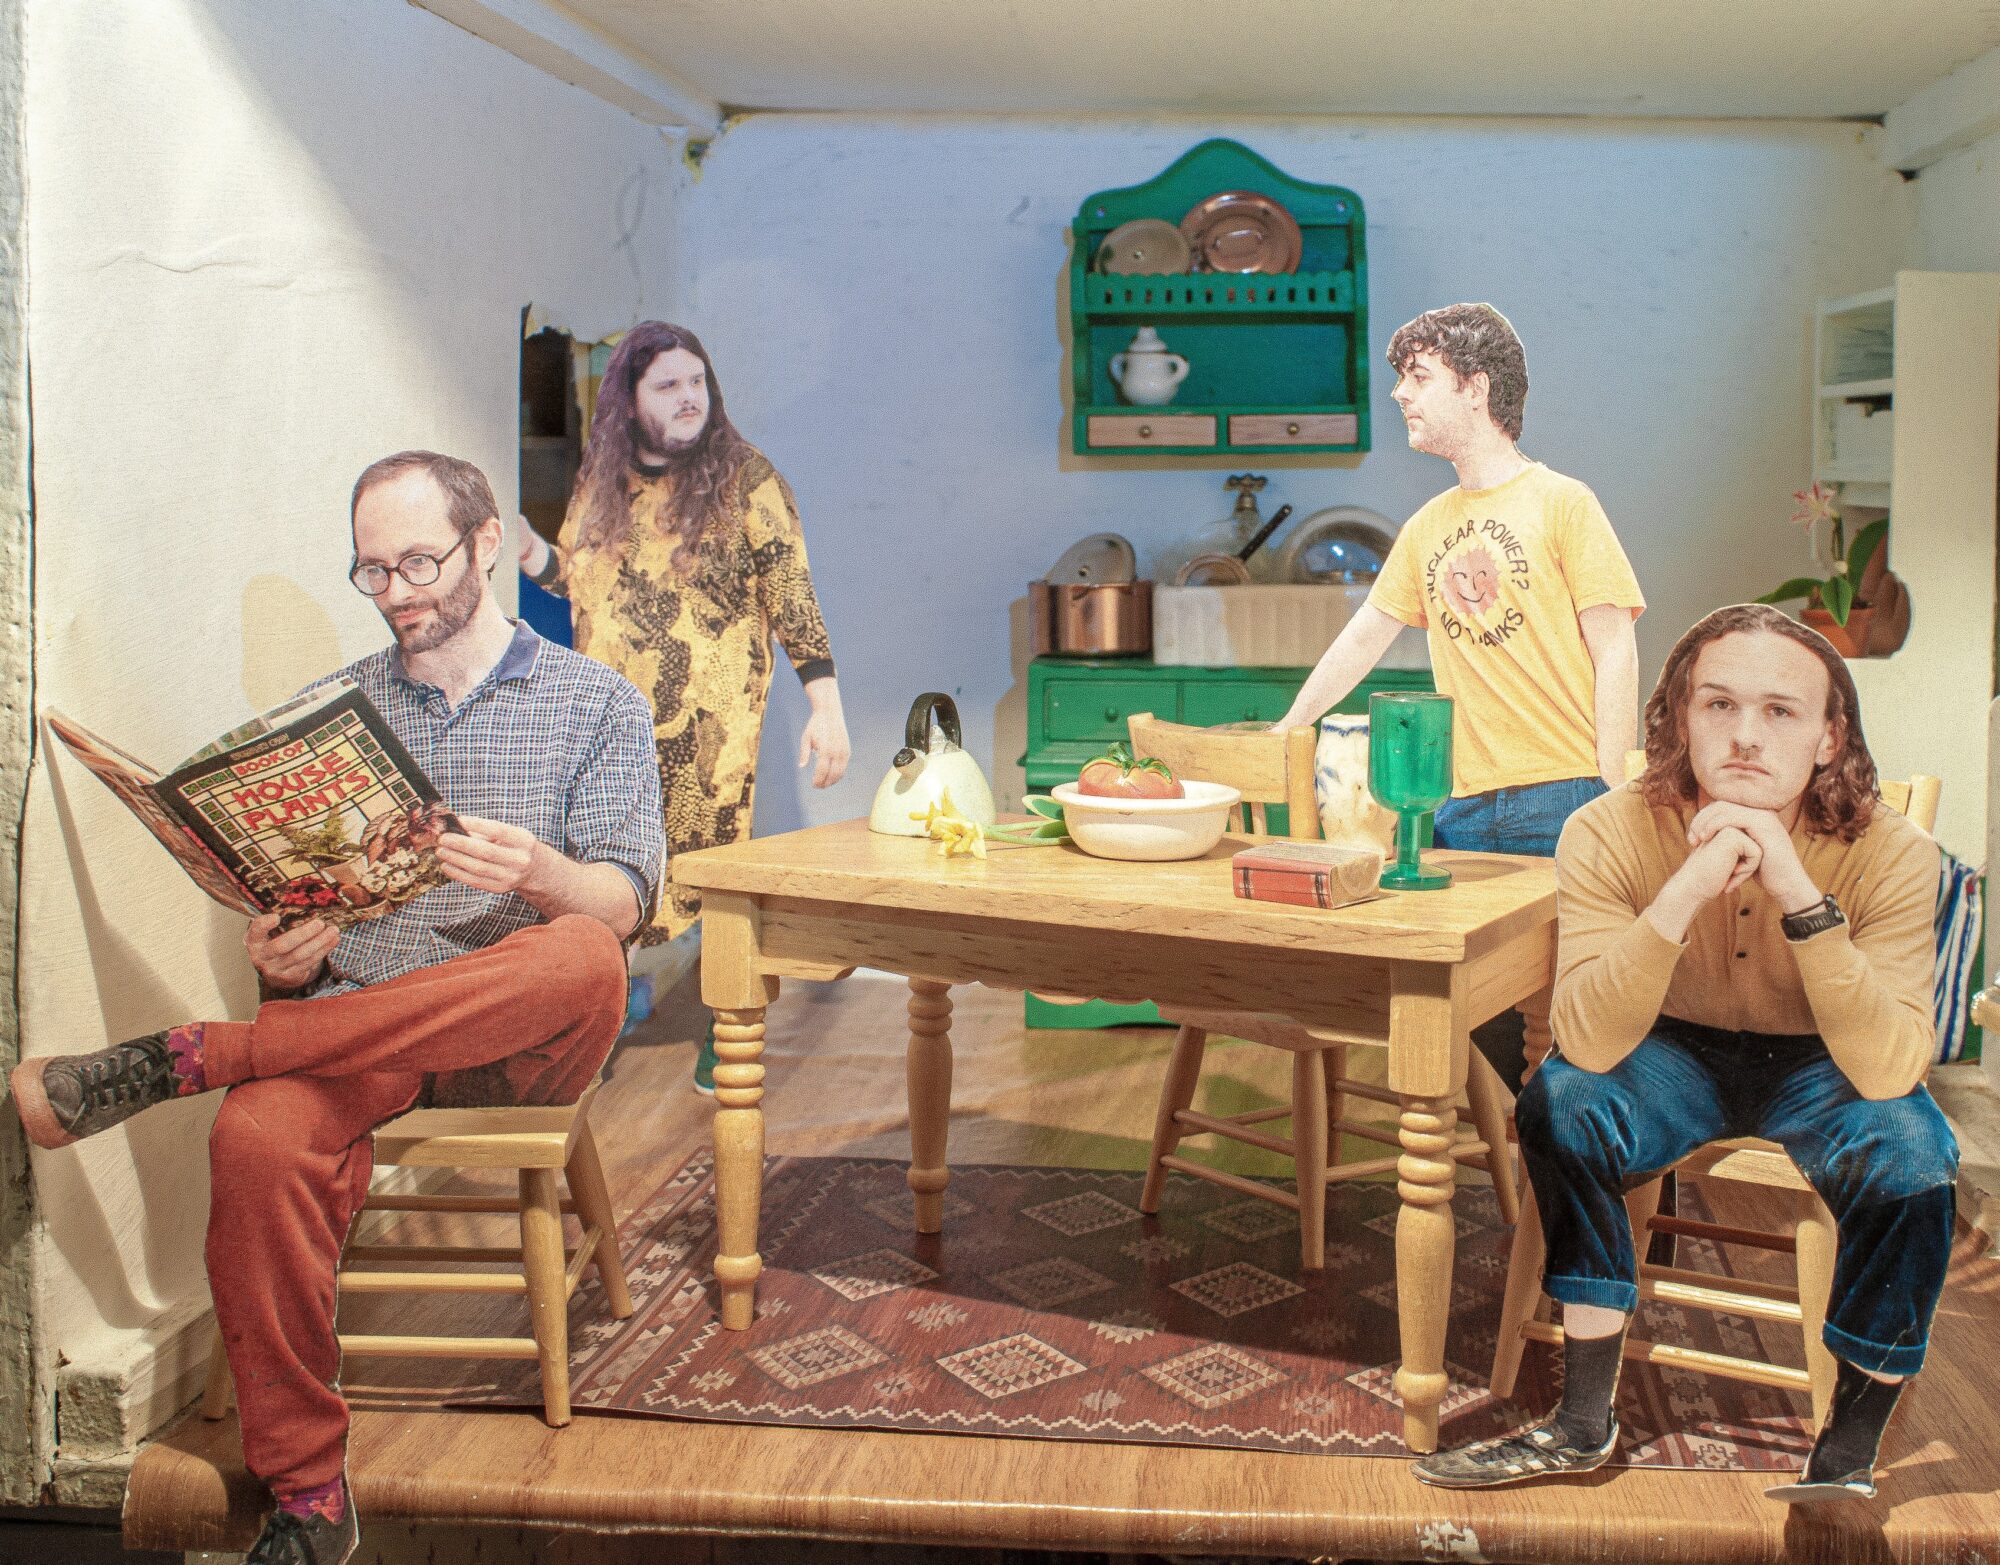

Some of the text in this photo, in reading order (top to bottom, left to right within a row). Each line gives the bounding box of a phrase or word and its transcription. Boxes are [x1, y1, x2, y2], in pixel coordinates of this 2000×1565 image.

[1480, 518, 1530, 590] POWER?
[1440, 611, 1463, 640] NO
[231, 751, 352, 809] HOUSE
[234, 751, 283, 776] BOOK
[282, 741, 305, 758] OF
[241, 769, 370, 832] PLANTS
